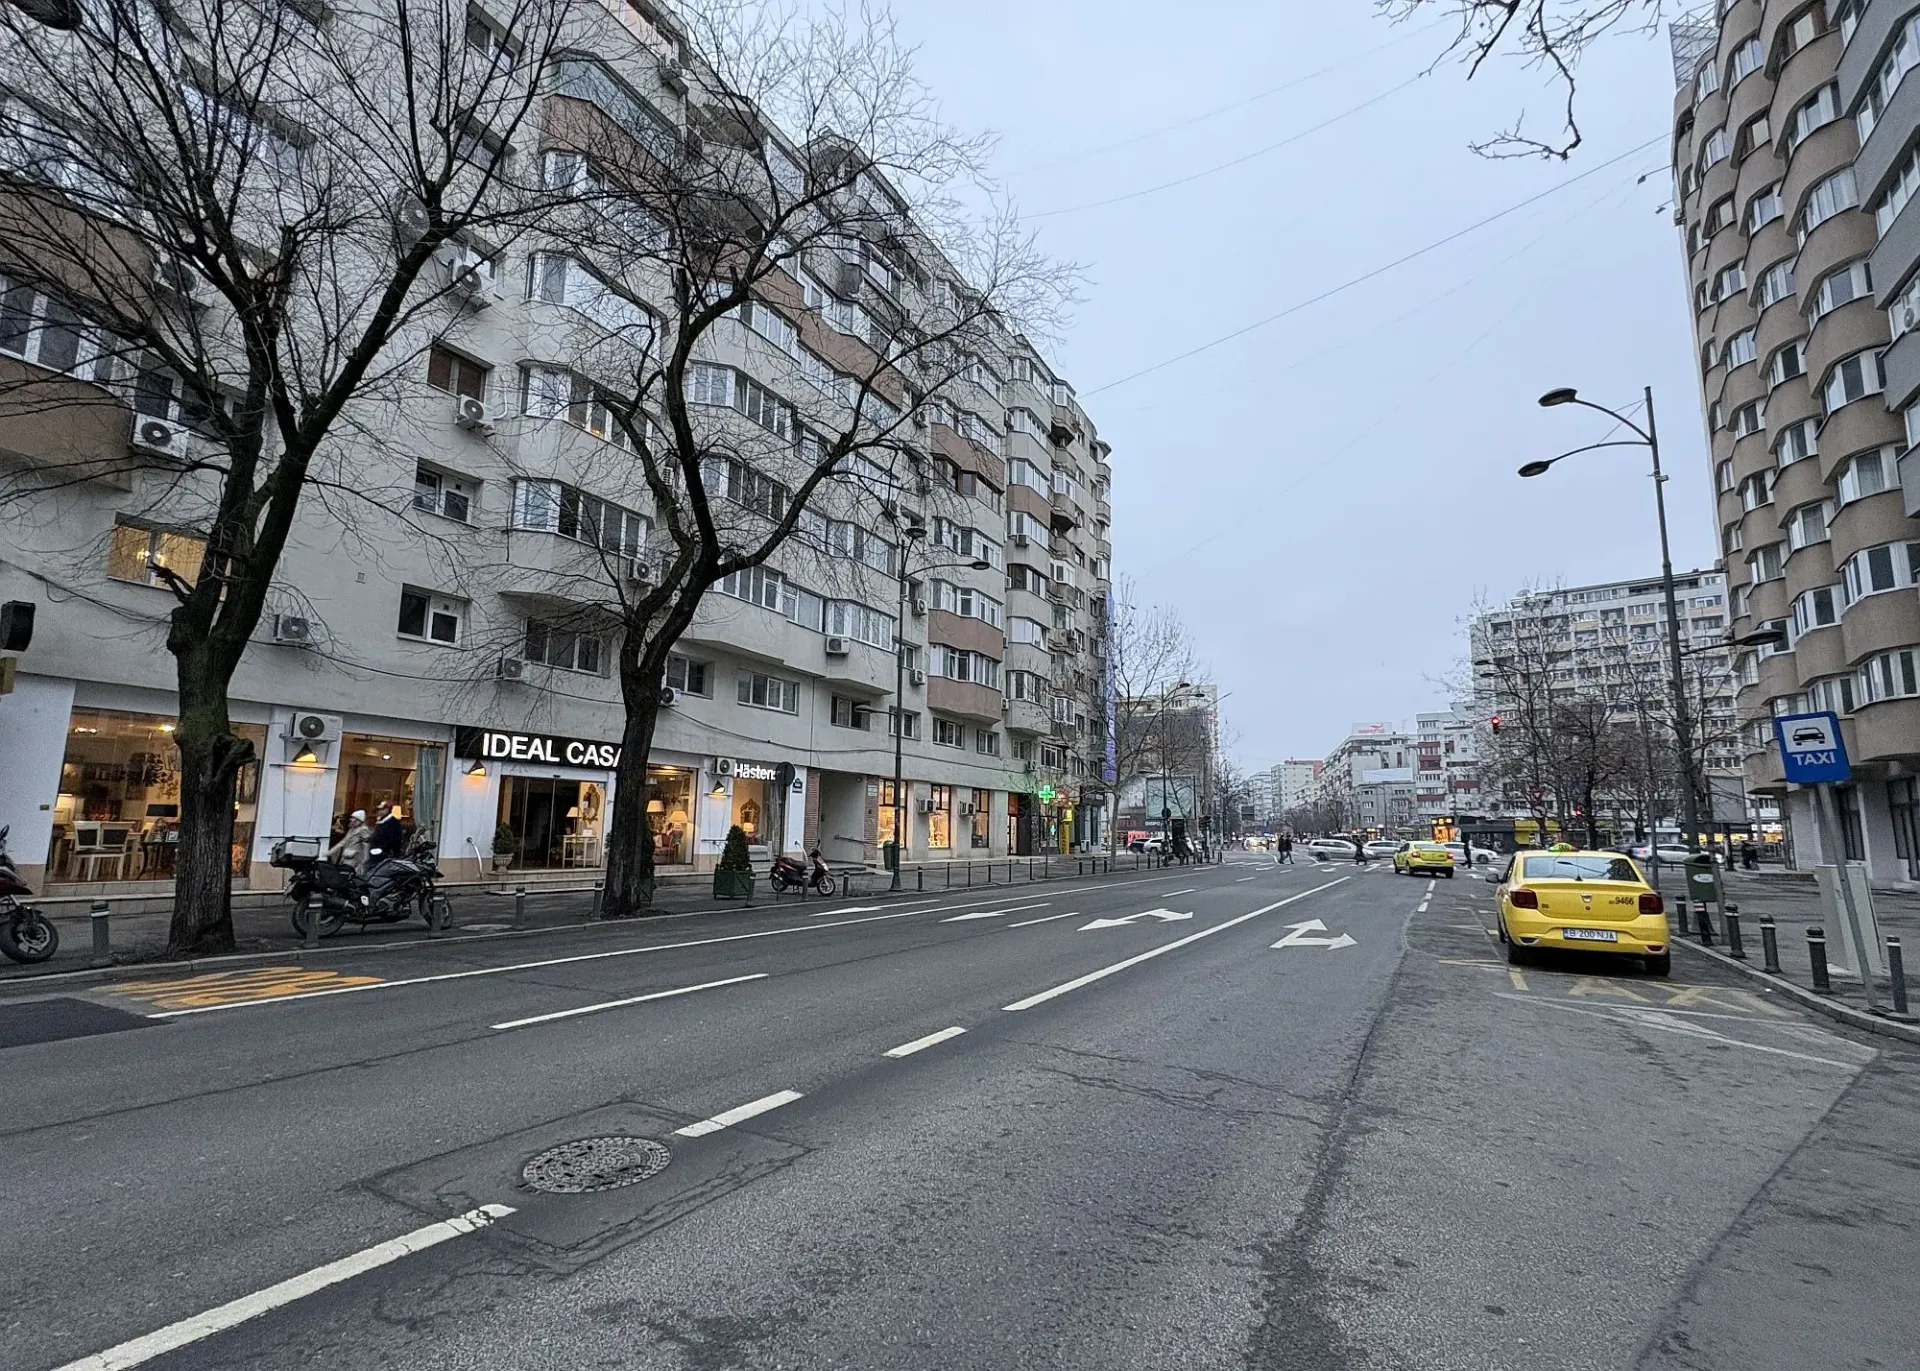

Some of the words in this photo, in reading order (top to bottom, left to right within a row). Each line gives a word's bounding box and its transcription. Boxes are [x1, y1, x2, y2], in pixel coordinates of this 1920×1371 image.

[482, 732, 560, 762] IDEAL
[1792, 751, 1837, 766] TAXI
[1615, 896, 1634, 906] 9466
[1569, 929, 1576, 937] B
[1579, 930, 1595, 938] 200
[1596, 931, 1615, 940] NJA
